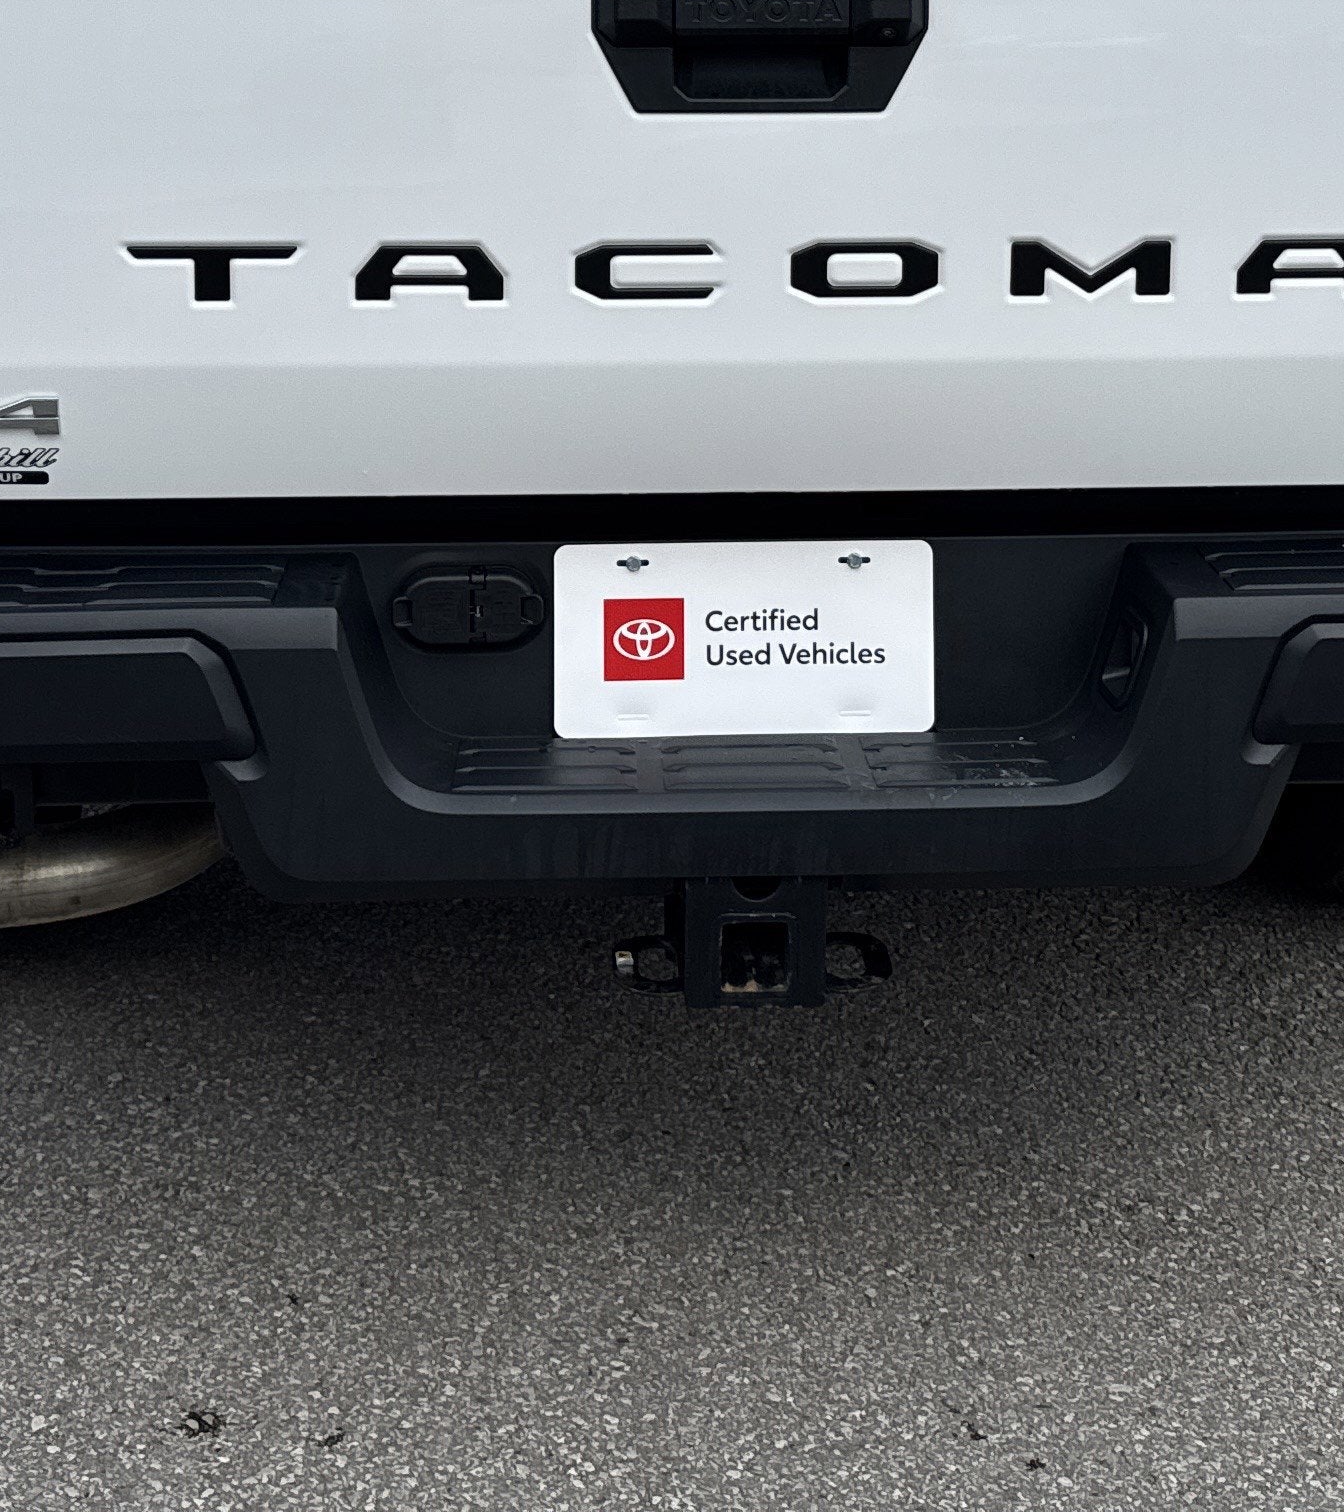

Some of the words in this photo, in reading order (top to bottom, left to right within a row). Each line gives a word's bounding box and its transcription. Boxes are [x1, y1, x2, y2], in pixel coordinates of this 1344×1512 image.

[704, 607, 820, 633] Certified
[704, 642, 772, 667] Used
[777, 641, 887, 666] Vehicles
